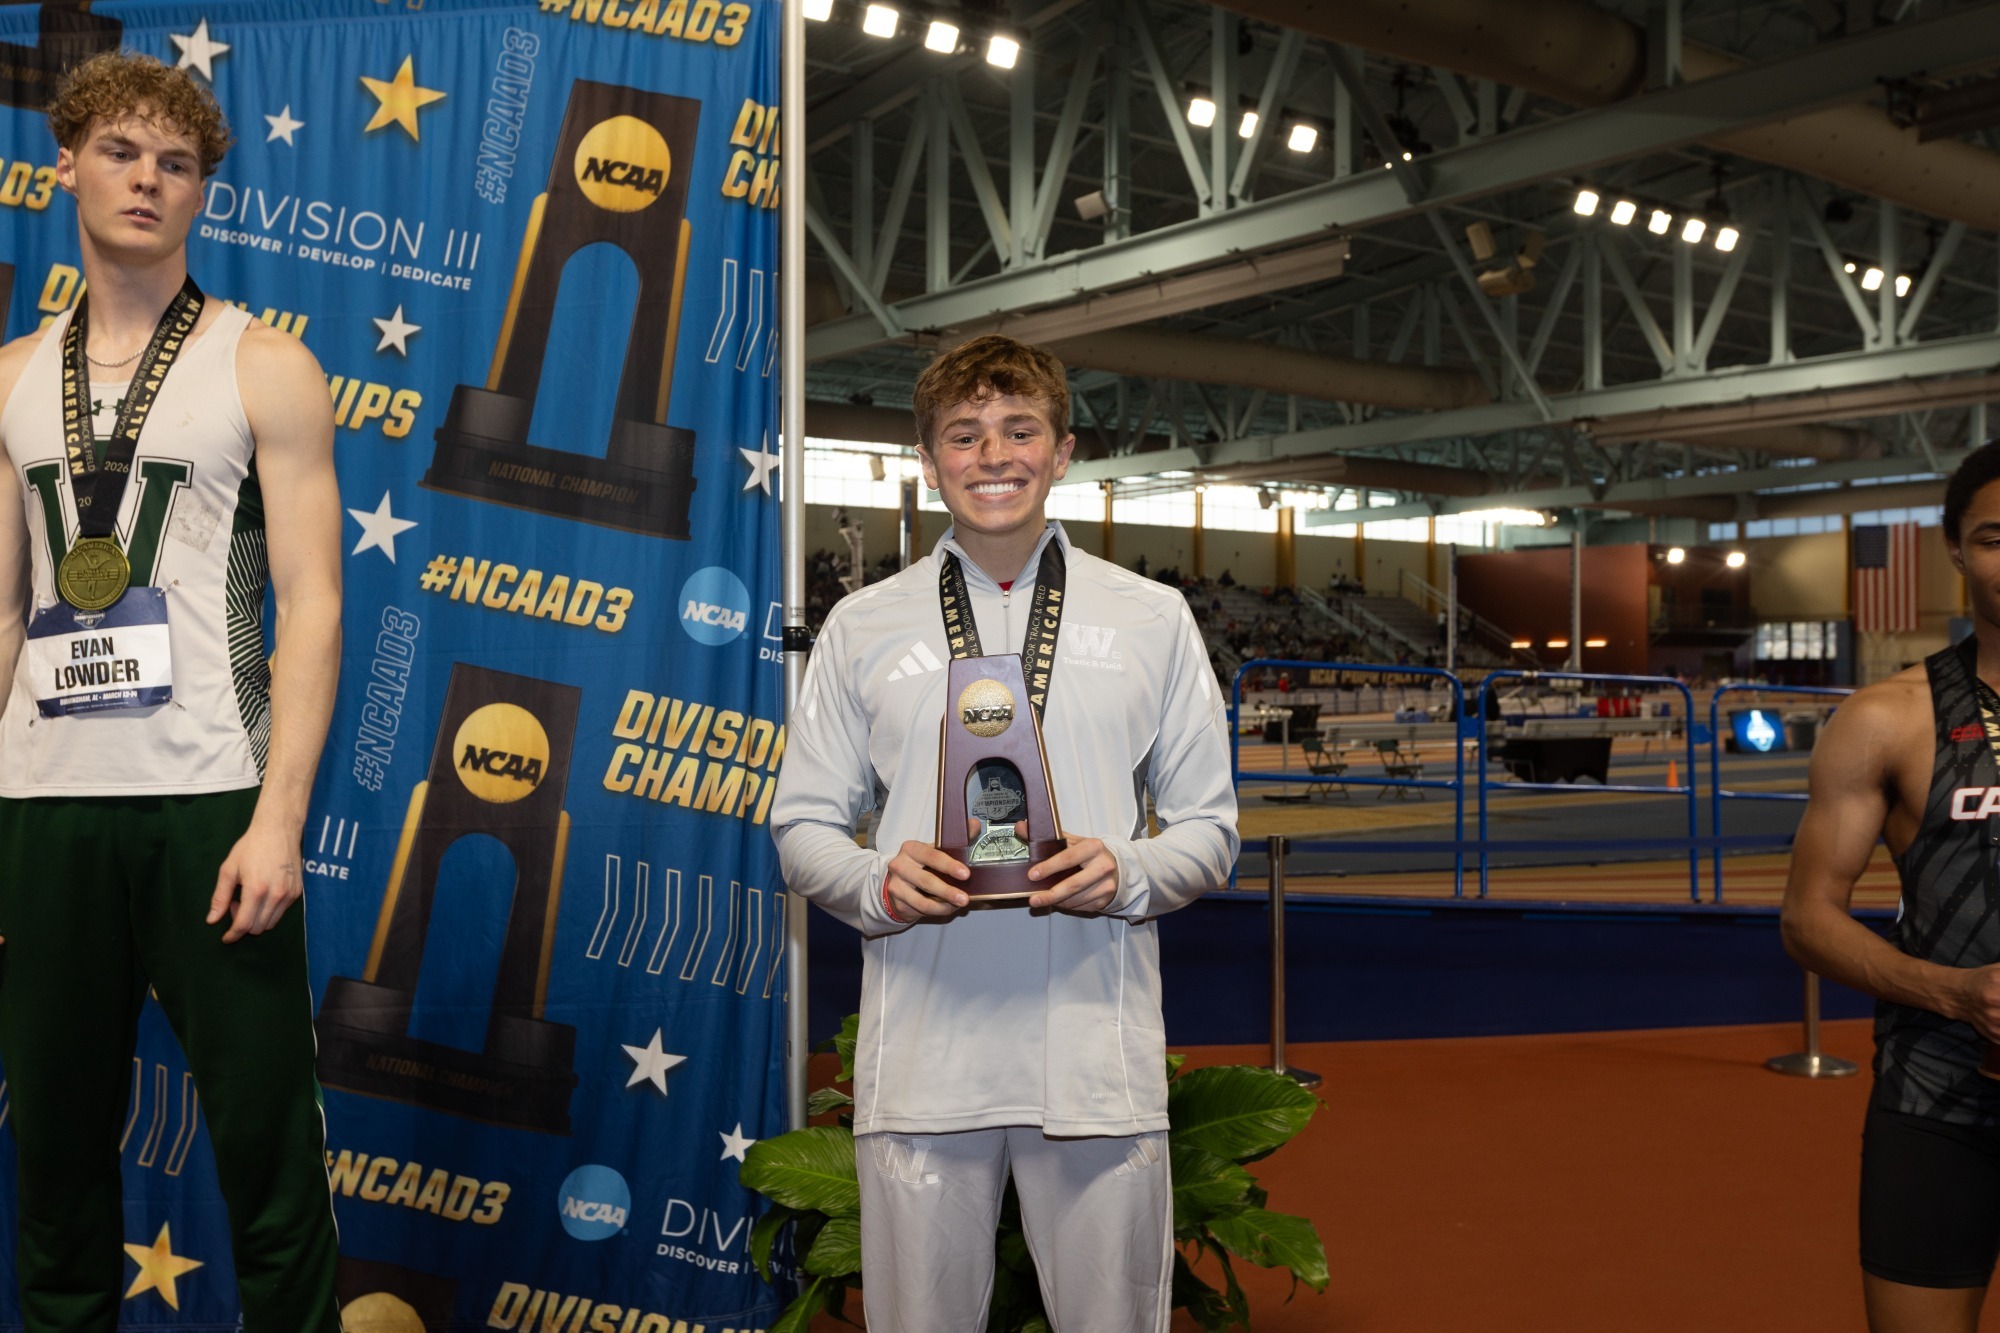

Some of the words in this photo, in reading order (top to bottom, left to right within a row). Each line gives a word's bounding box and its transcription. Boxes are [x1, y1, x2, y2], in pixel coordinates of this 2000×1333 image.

[475, 27, 540, 204] #NCAAD3
[581, 156, 664, 197] NCAA
[204, 181, 424, 259] DIVISION
[444, 229, 481, 270] III
[200, 224, 282, 254] DISCOVER
[298, 245, 375, 272] DEVELOP
[391, 263, 472, 291] DEDICATE
[126, 298, 201, 441] ALL-AMERICAN
[64, 325, 85, 475] ALL-AMERICAN
[104, 461, 130, 473] 2026
[488, 460, 557, 488] NATIONAL
[559, 474, 640, 504] CHAMPION
[420, 554, 634, 633] #NCAAD3
[1030, 614, 1041, 641] TRACK
[1036, 584, 1047, 606] FIELD
[682, 600, 747, 633] NCAA
[961, 607, 975, 643] INDOOR
[71, 636, 115, 660] EVAN
[55, 658, 141, 691] LOWDER
[103, 692, 122, 700] MARCH
[353, 605, 421, 792] #NCAAD3
[963, 704, 1013, 724] NCAA
[459, 744, 543, 788] NCAA
[365, 1053, 435, 1081] NATIONAL
[326, 1149, 511, 1225] NCAAD3
[562, 1195, 627, 1229] NCAA
[656, 1243, 739, 1275] DISCOVER
